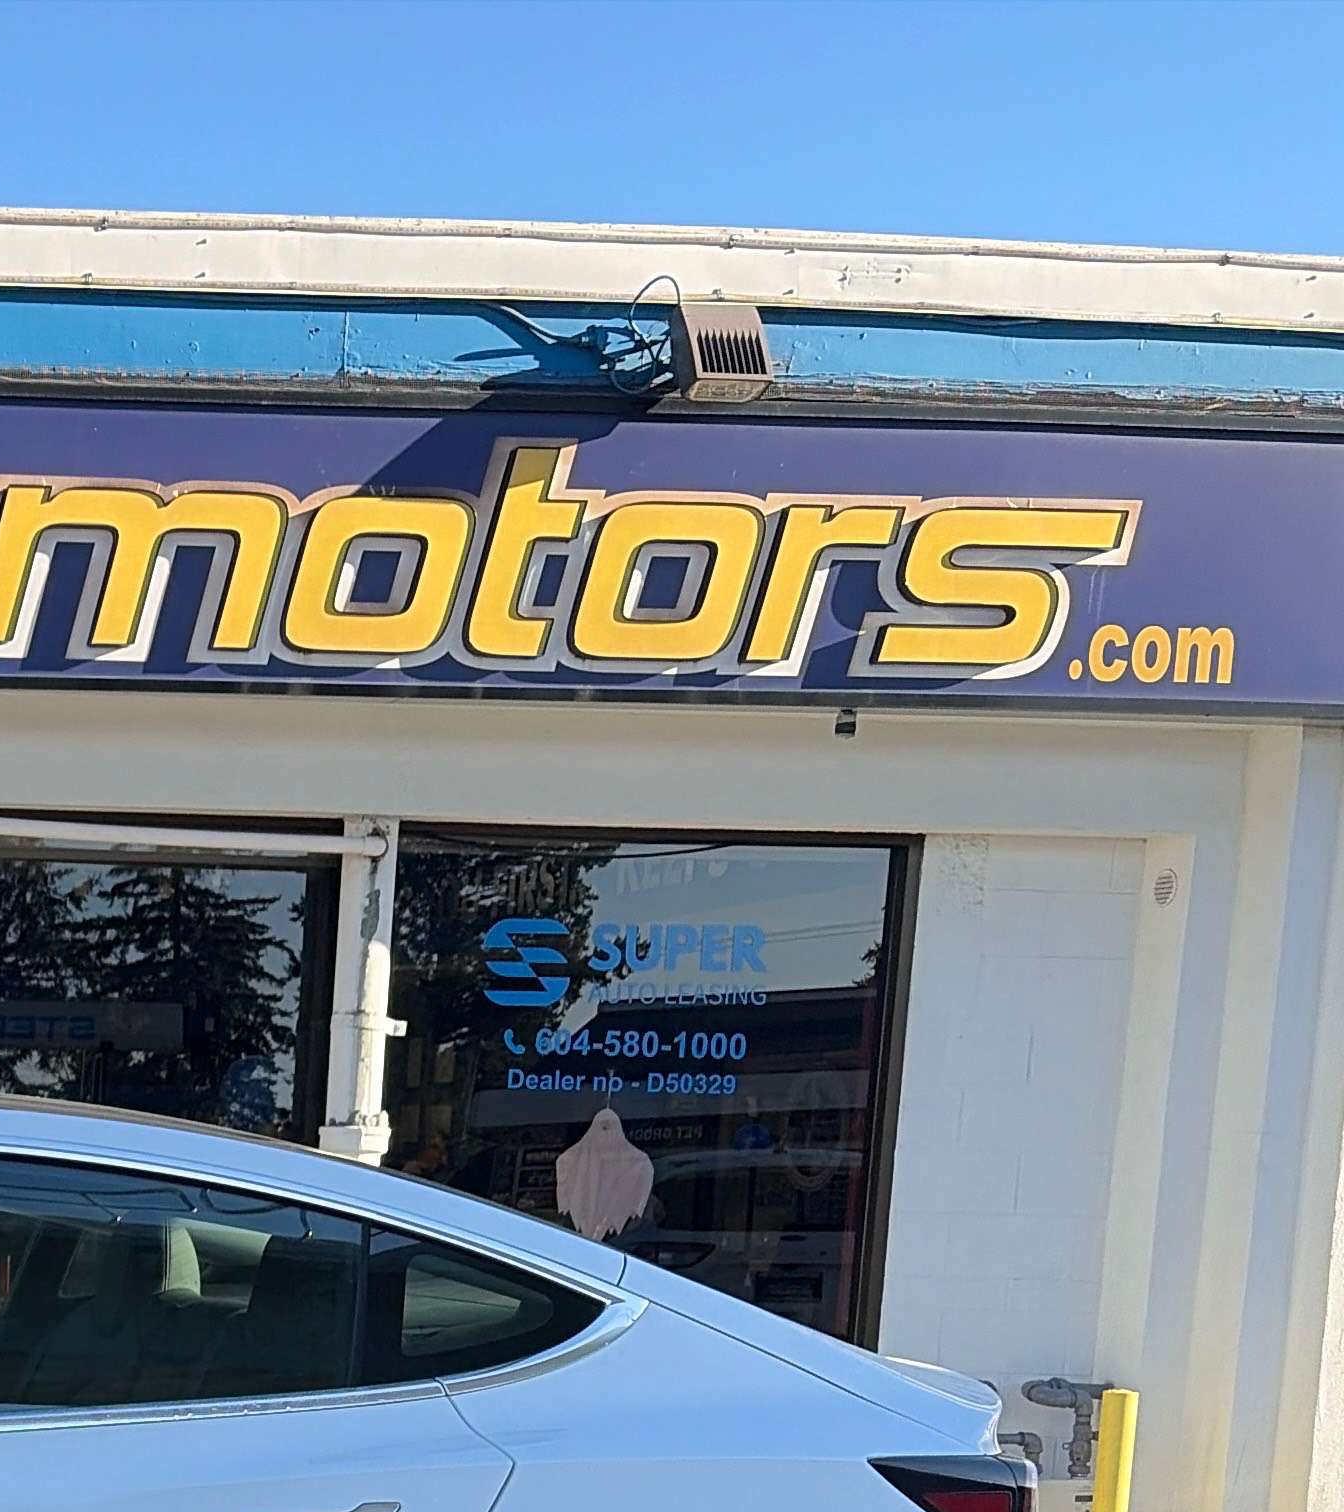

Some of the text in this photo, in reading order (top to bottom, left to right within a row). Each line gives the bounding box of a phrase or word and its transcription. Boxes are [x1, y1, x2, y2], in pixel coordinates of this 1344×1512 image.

[587, 921, 768, 973] SUPER
[588, 982, 768, 1006] AUTO LEASING
[535, 1027, 748, 1060] 604-580-1000
[507, 1068, 585, 1091] Dealer
[647, 1072, 737, 1096] D50329
